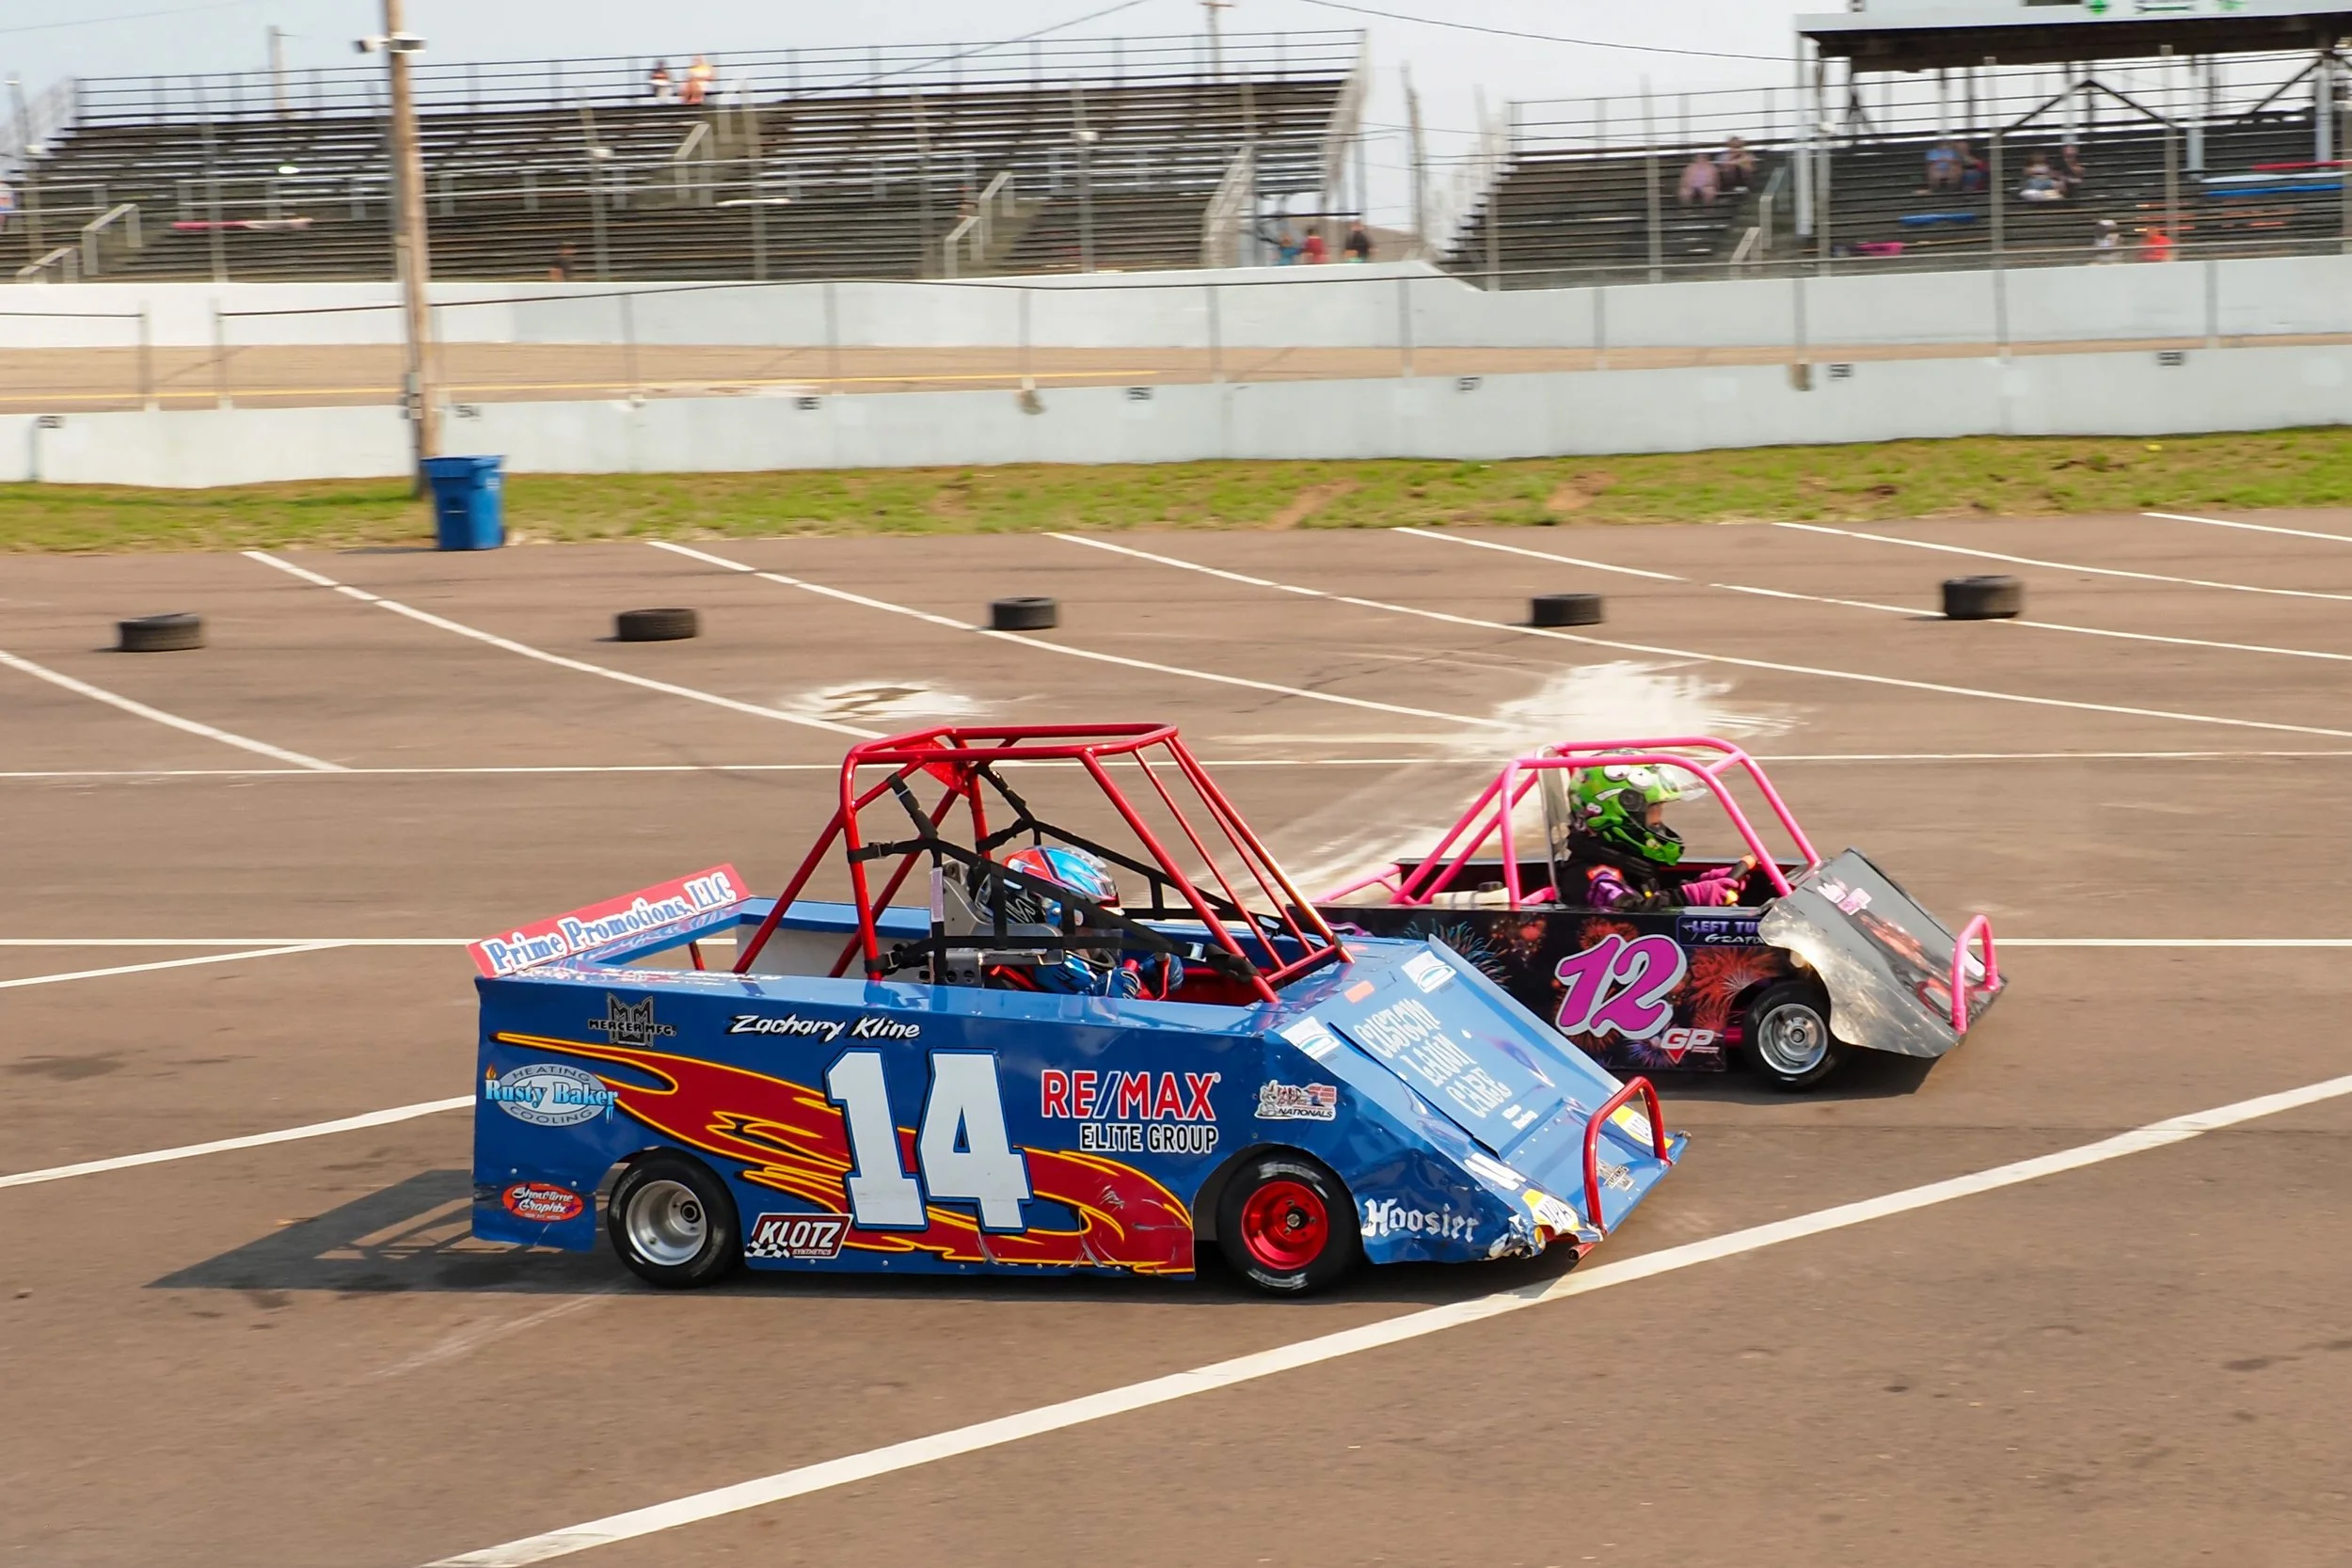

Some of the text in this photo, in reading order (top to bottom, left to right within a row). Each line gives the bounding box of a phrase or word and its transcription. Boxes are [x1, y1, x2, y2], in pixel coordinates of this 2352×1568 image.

[484, 934, 565, 970] Prime
[687, 872, 736, 909] LLC
[1692, 921, 1759, 933] LEFT TU
[1555, 934, 1687, 1038] 12
[588, 1019, 643, 1033] MERCER
[730, 1013, 921, 1042] Zachary Kline
[1353, 997, 1441, 1059] CUSTOM
[1661, 1027, 1715, 1051] GP
[511, 1066, 591, 1083] HEATING
[1399, 1033, 1478, 1087] LAWN
[485, 1079, 618, 1109] Rusty Baker
[1041, 1069, 1217, 1121] RE/MAX
[1445, 1067, 1513, 1118] CARE
[510, 1106, 593, 1125] COOLING
[1279, 1108, 1333, 1118] NATIONALS
[827, 1050, 1031, 1229] 14
[1080, 1124, 1218, 1154] ELITE GROUP
[757, 1221, 842, 1248] KLOTZ
[1361, 1197, 1481, 1243] Hoosier
